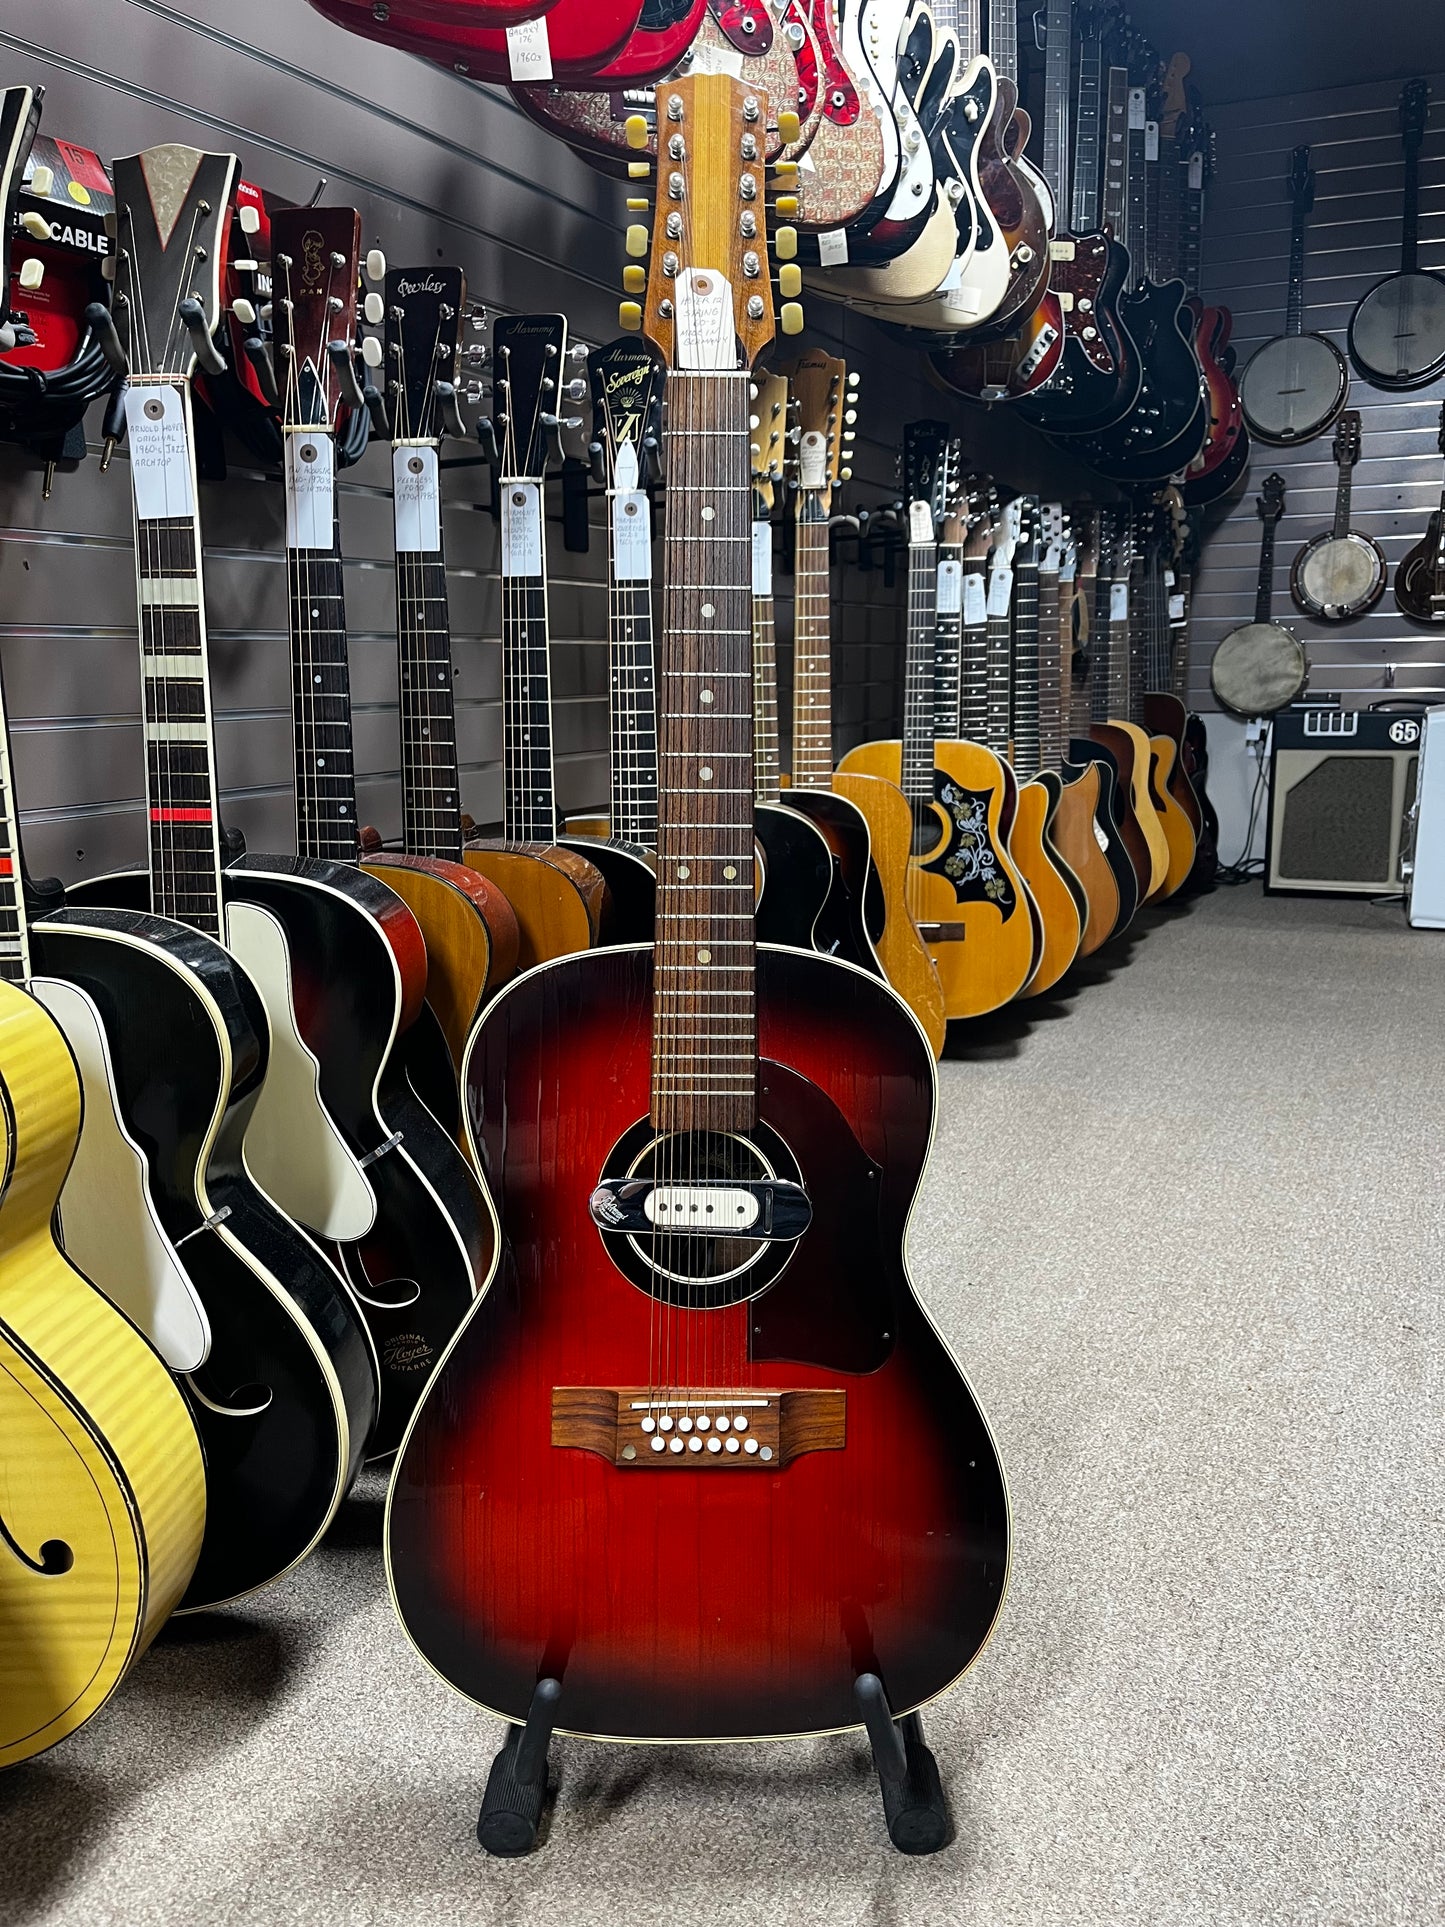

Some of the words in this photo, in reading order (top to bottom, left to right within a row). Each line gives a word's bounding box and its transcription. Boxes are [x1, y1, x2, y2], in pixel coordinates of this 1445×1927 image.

[519, 34, 532, 44] 176
[64, 146, 85, 166] 15
[49, 221, 109, 255] CABLE
[397, 273, 447, 298] Peerless
[506, 320, 556, 337] Harmony
[602, 348, 652, 365] Harmony
[606, 365, 650, 394] Sovereign
[130, 425, 159, 433] ARNOLD
[136, 434, 176, 443] ORIGINAL
[134, 457, 172, 467] ARCHTOP
[1390, 721, 1418, 742] 65
[384, 1333, 426, 1347] ORIGINAL
[383, 1344, 434, 1366] Hoyer
[390, 1358, 432, 1372] GITARRE
